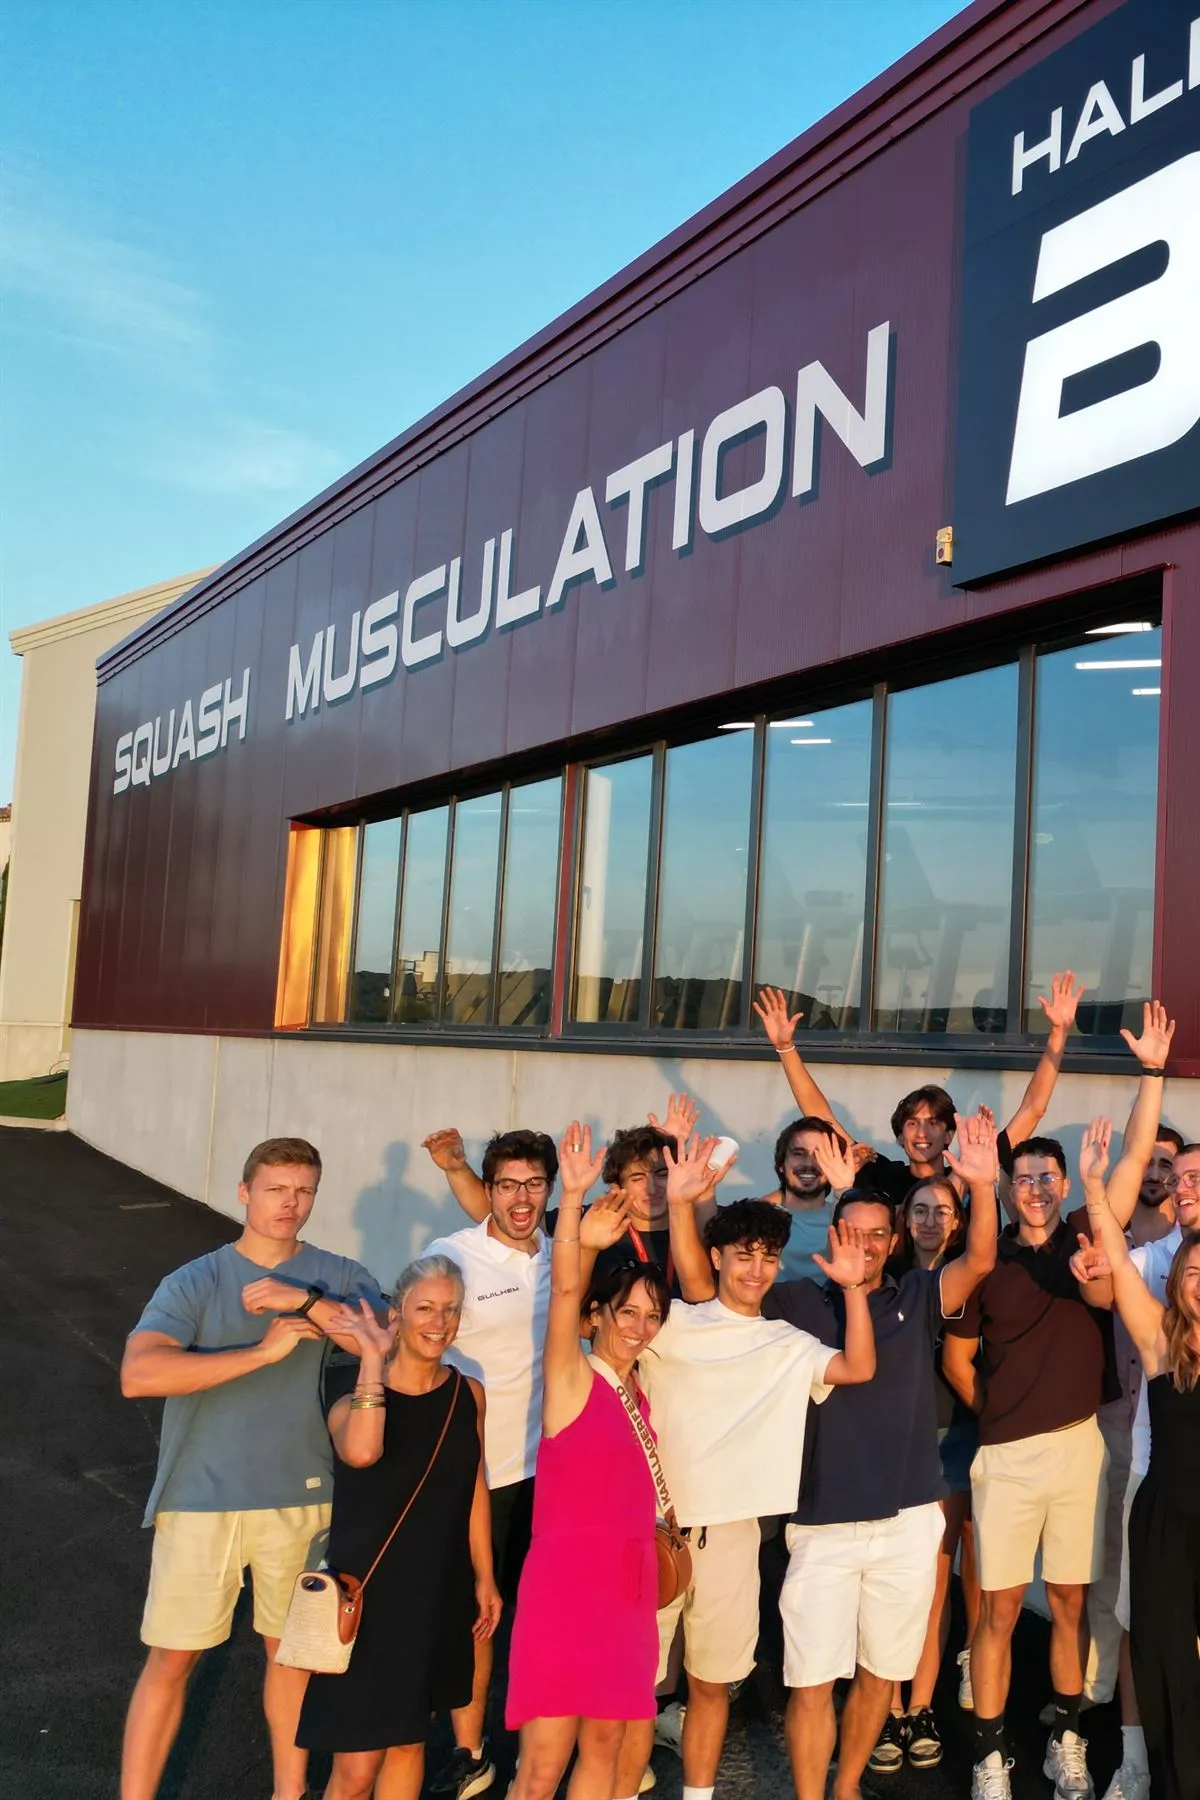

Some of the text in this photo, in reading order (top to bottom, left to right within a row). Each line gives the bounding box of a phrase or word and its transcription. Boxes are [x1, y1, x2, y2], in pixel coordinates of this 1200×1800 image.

[285, 320, 891, 720] MUSCULATION
[113, 666, 251, 795] SQUASH
[477, 1286, 520, 1302] GUILHEM
